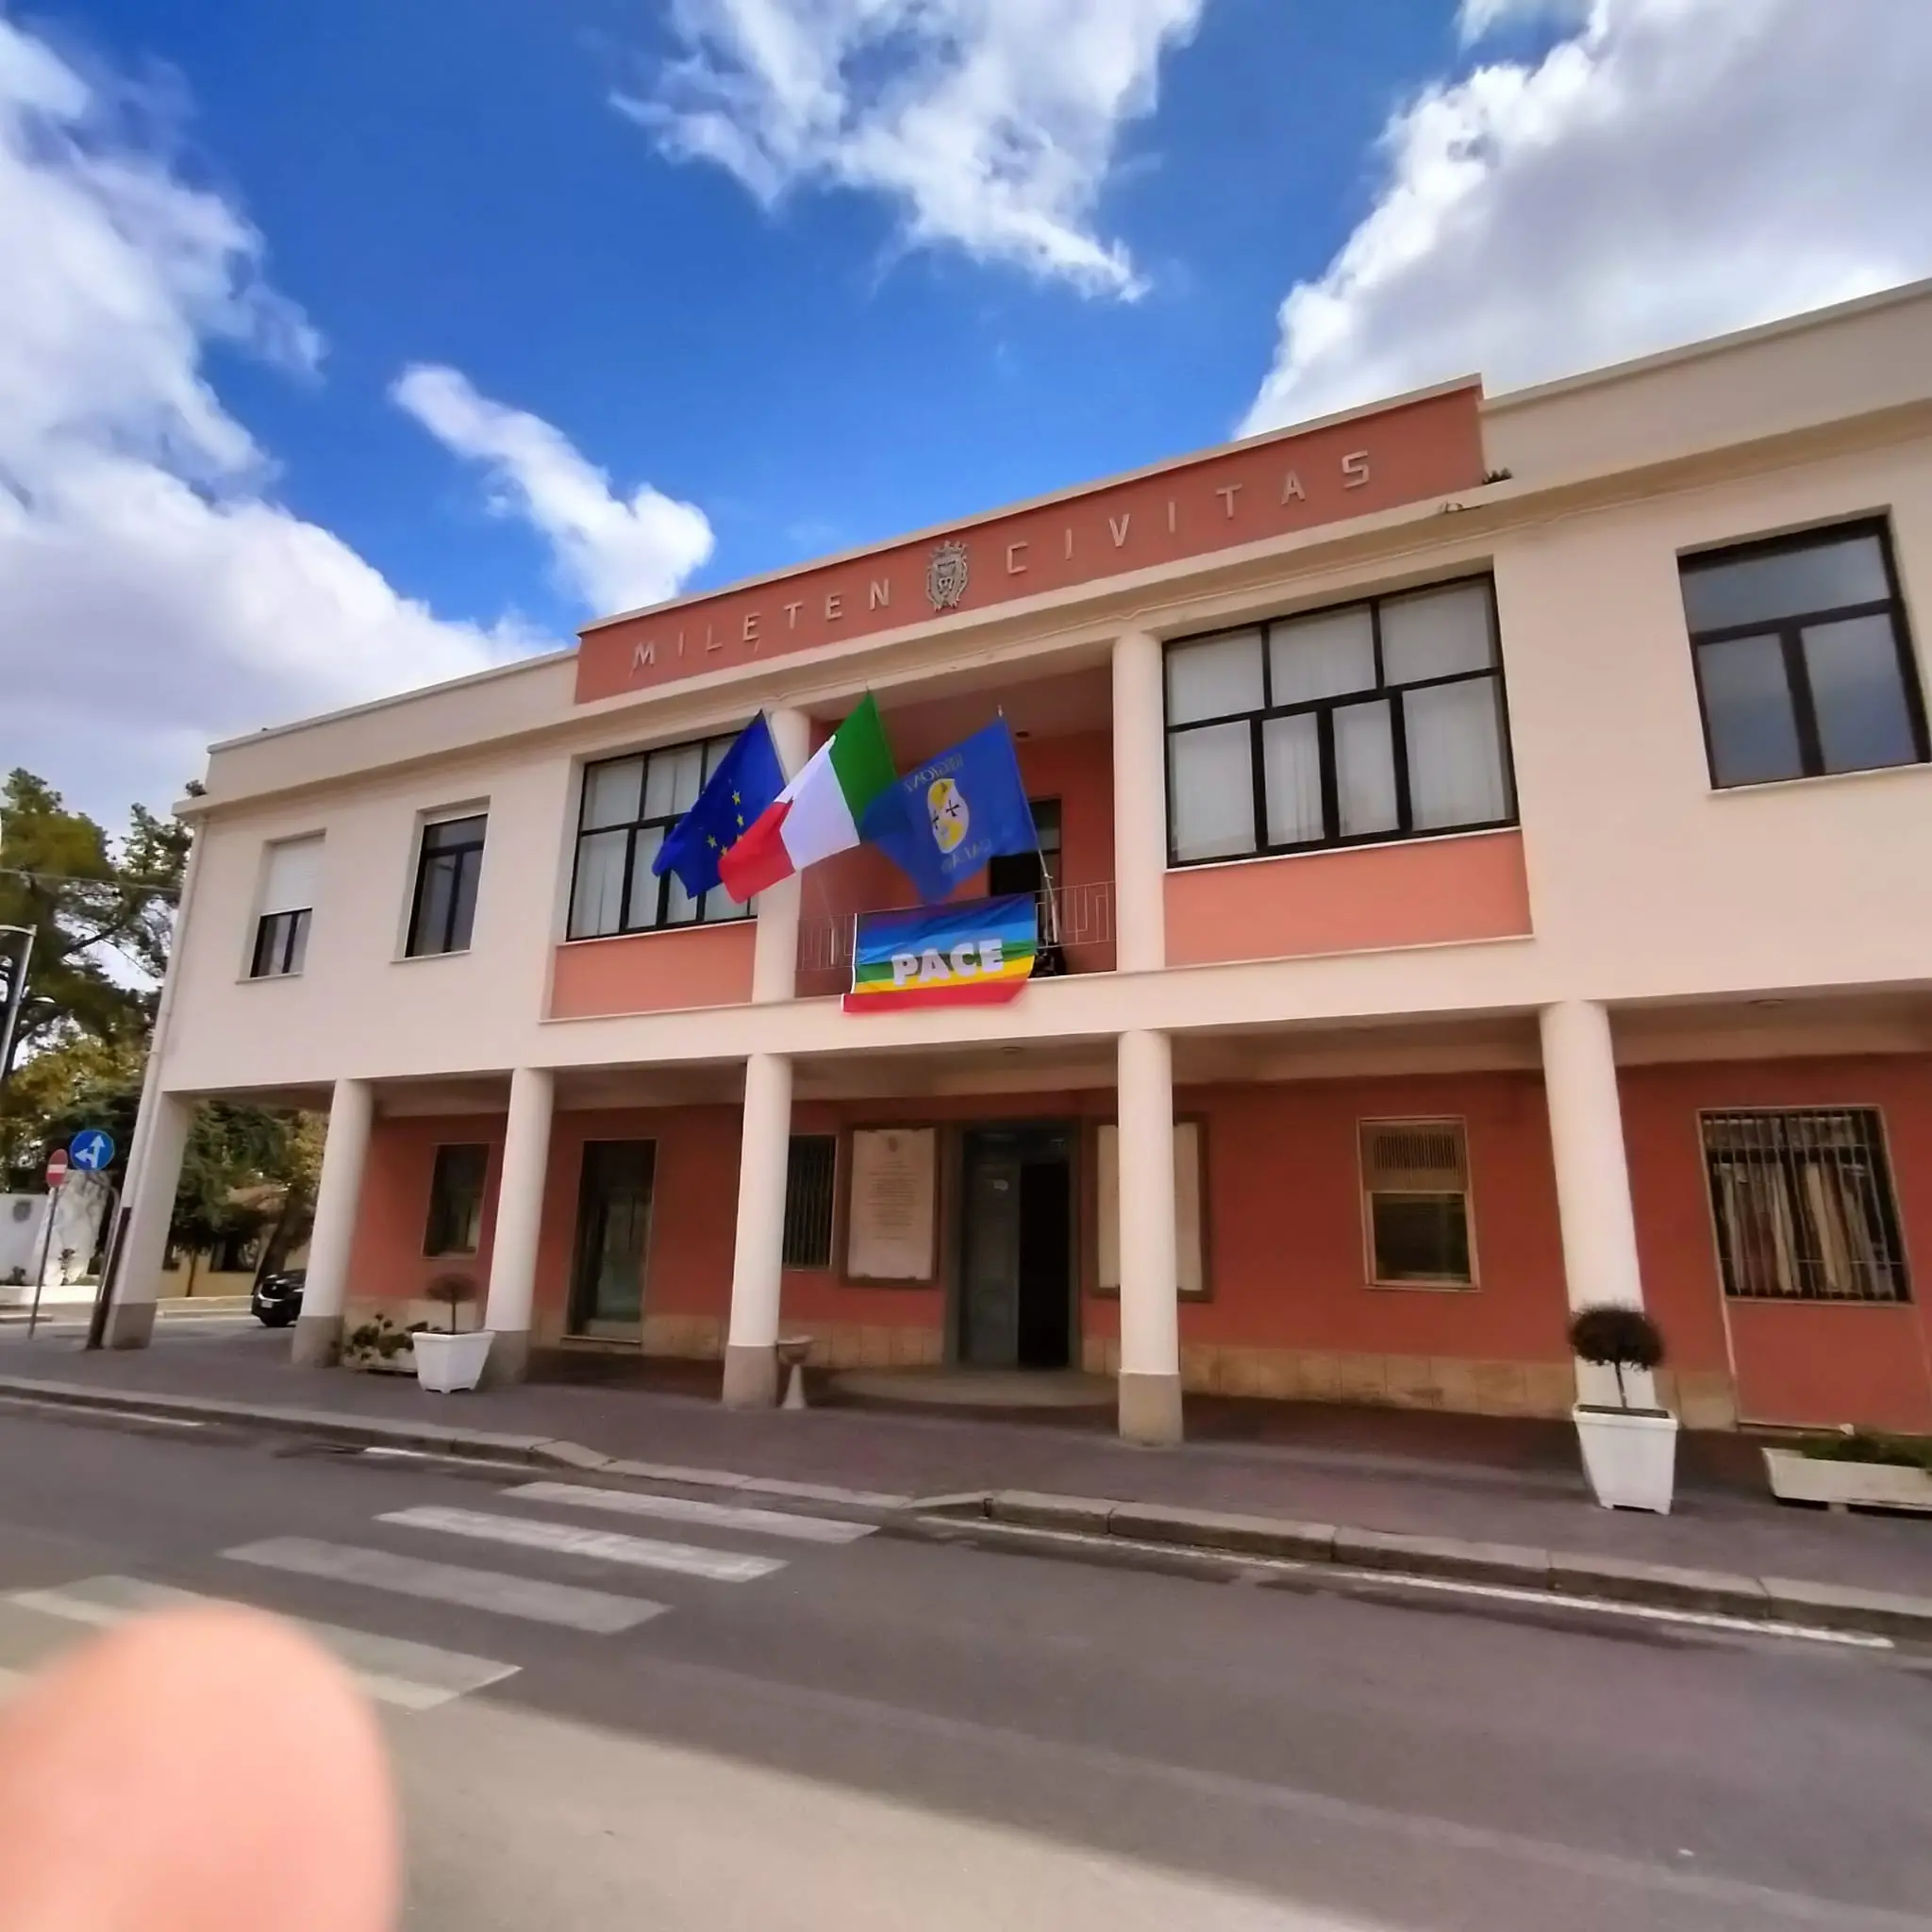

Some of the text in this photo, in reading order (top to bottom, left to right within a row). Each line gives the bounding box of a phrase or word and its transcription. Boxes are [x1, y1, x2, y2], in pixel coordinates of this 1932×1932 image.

[632, 450, 1370, 667] MILETEN CIVITAS
[891, 938, 1003, 986] PACE
